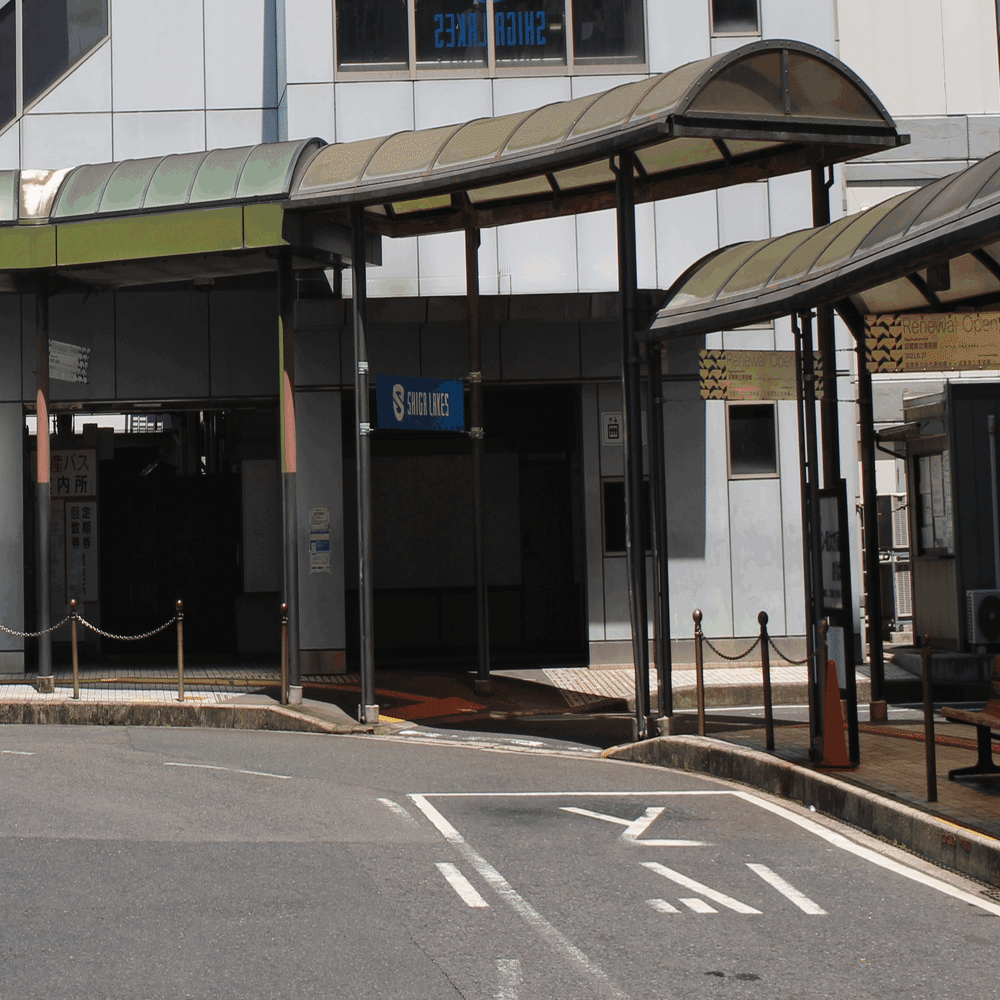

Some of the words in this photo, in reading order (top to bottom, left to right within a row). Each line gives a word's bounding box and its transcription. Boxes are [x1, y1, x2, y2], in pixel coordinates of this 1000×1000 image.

[407, 391, 428, 416] SHIGA
[428, 392, 450, 417] LAKES
[50, 453, 90, 474] 産バス
